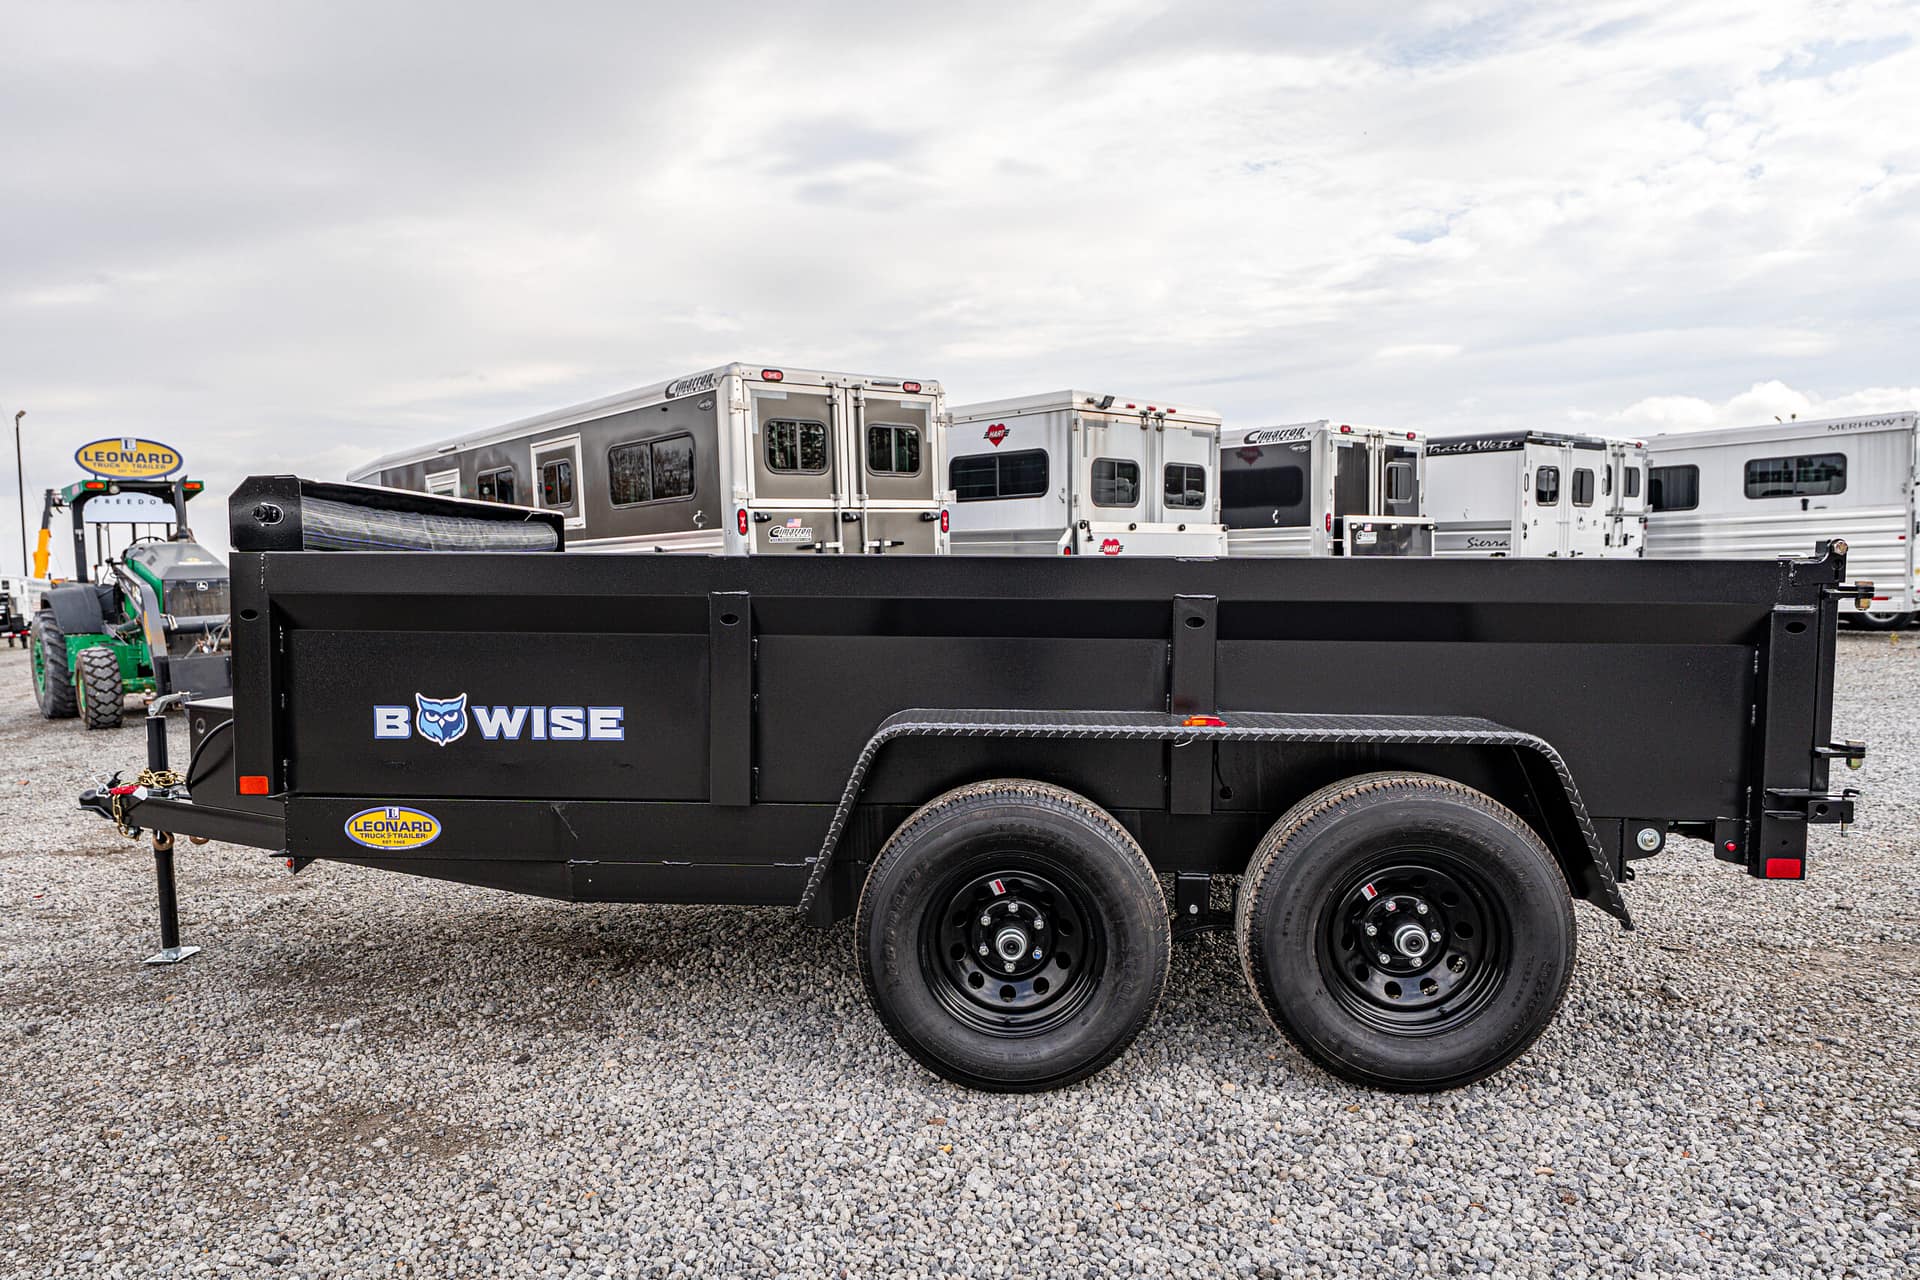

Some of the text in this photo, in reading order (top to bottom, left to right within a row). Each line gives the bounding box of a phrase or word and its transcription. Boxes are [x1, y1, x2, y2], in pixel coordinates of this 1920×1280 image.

[1828, 418, 1897, 432] MERHOW
[989, 430, 1005, 438] HART
[1244, 427, 1306, 444] Cimarron
[1426, 440, 1513, 454] Trails West
[84, 451, 173, 464] LEONARD
[1467, 537, 1508, 548] Sierra
[354, 821, 432, 832] LEONARD
